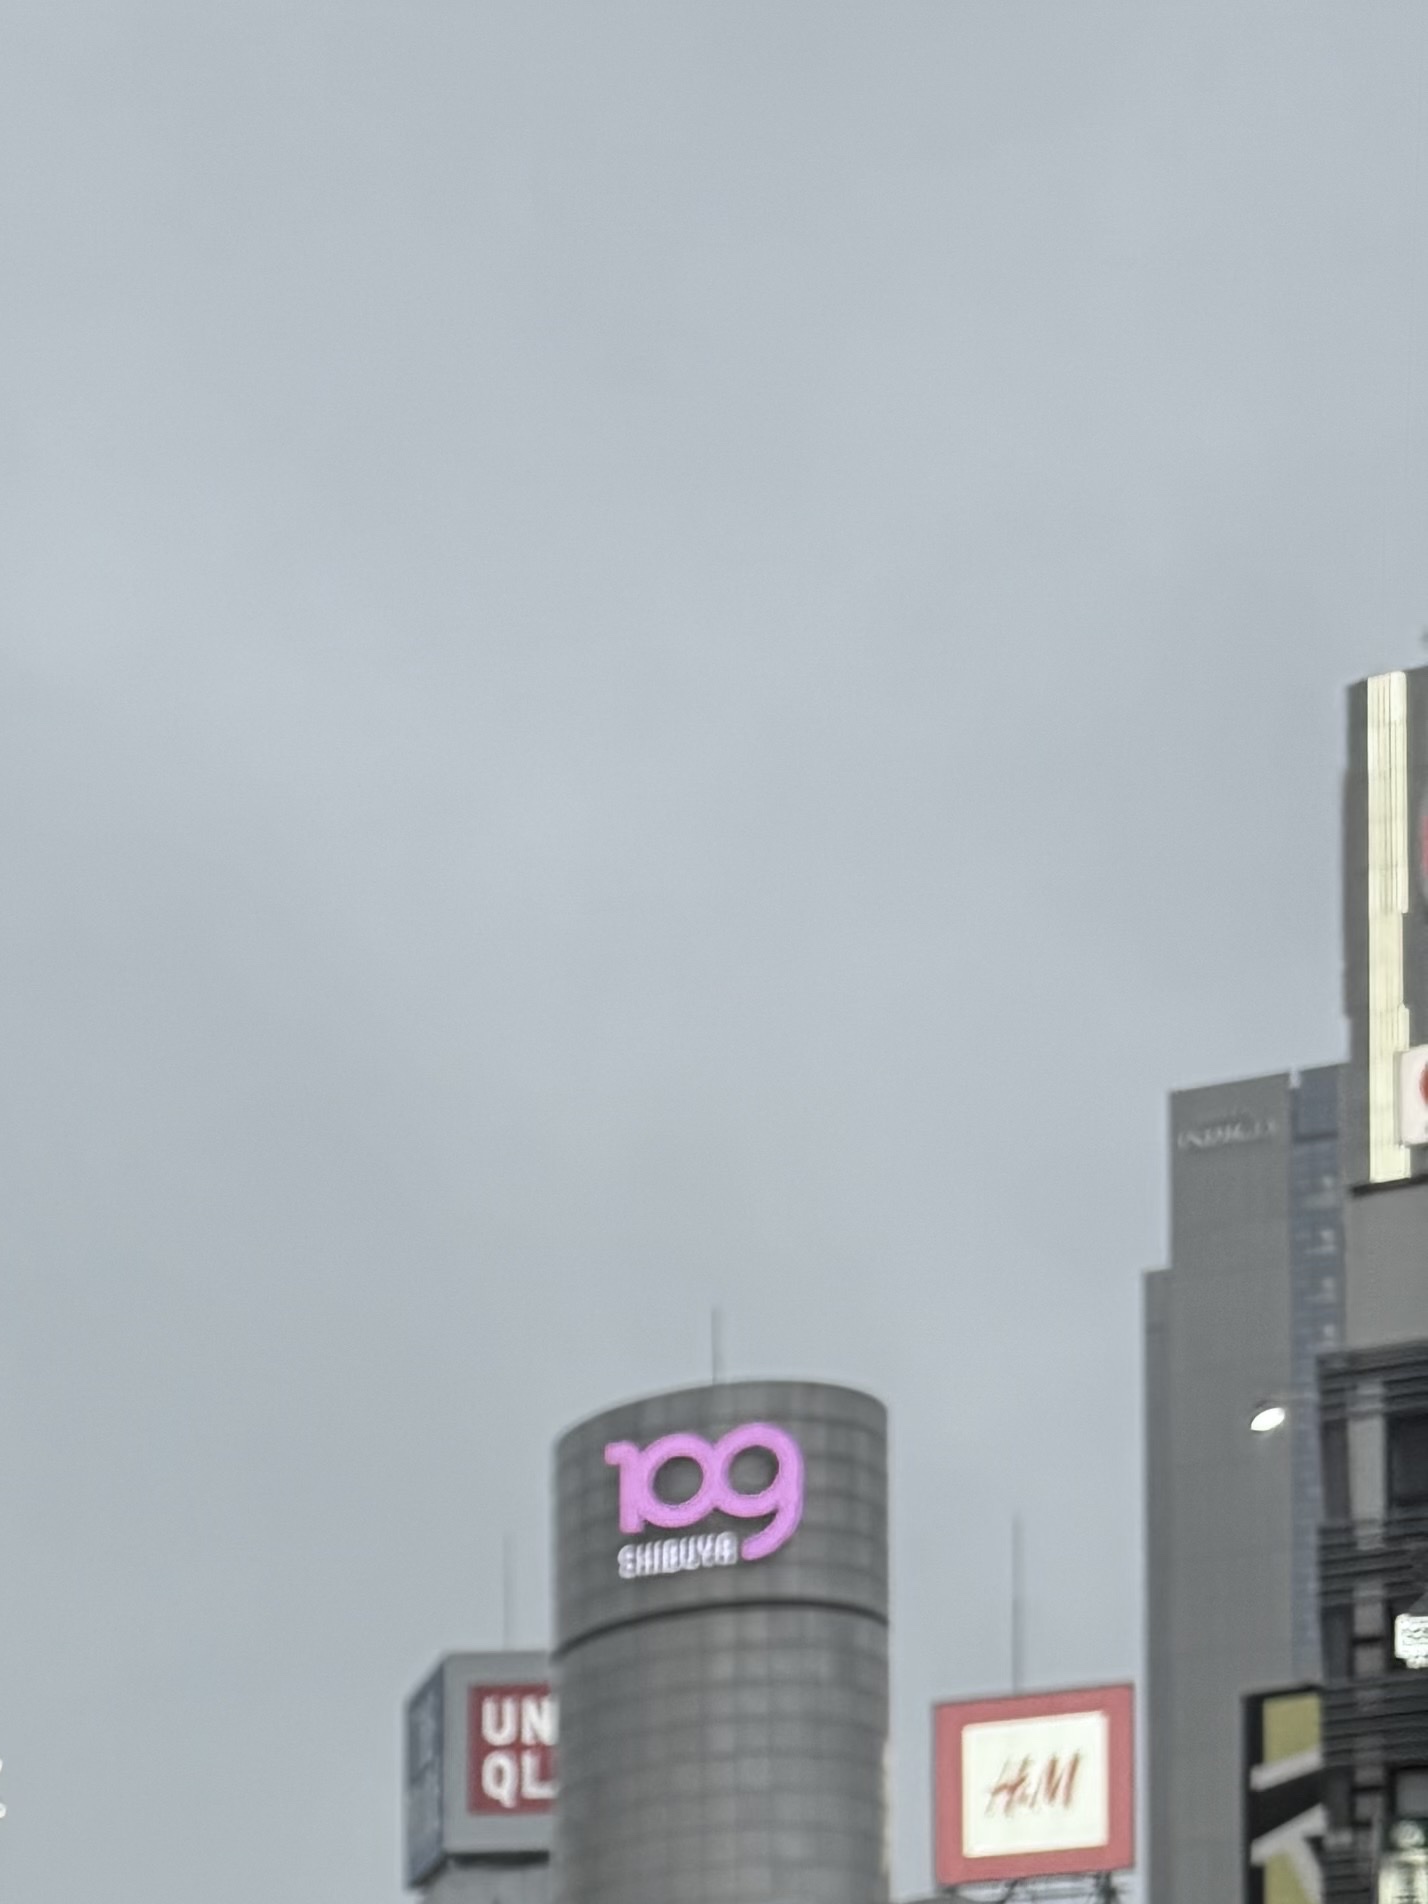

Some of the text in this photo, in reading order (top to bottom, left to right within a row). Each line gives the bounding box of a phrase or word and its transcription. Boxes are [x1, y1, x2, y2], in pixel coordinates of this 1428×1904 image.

[603, 1421, 807, 1561] 109
[617, 1531, 739, 1579] SHIBUYA
[984, 1748, 1082, 1819] H&M
